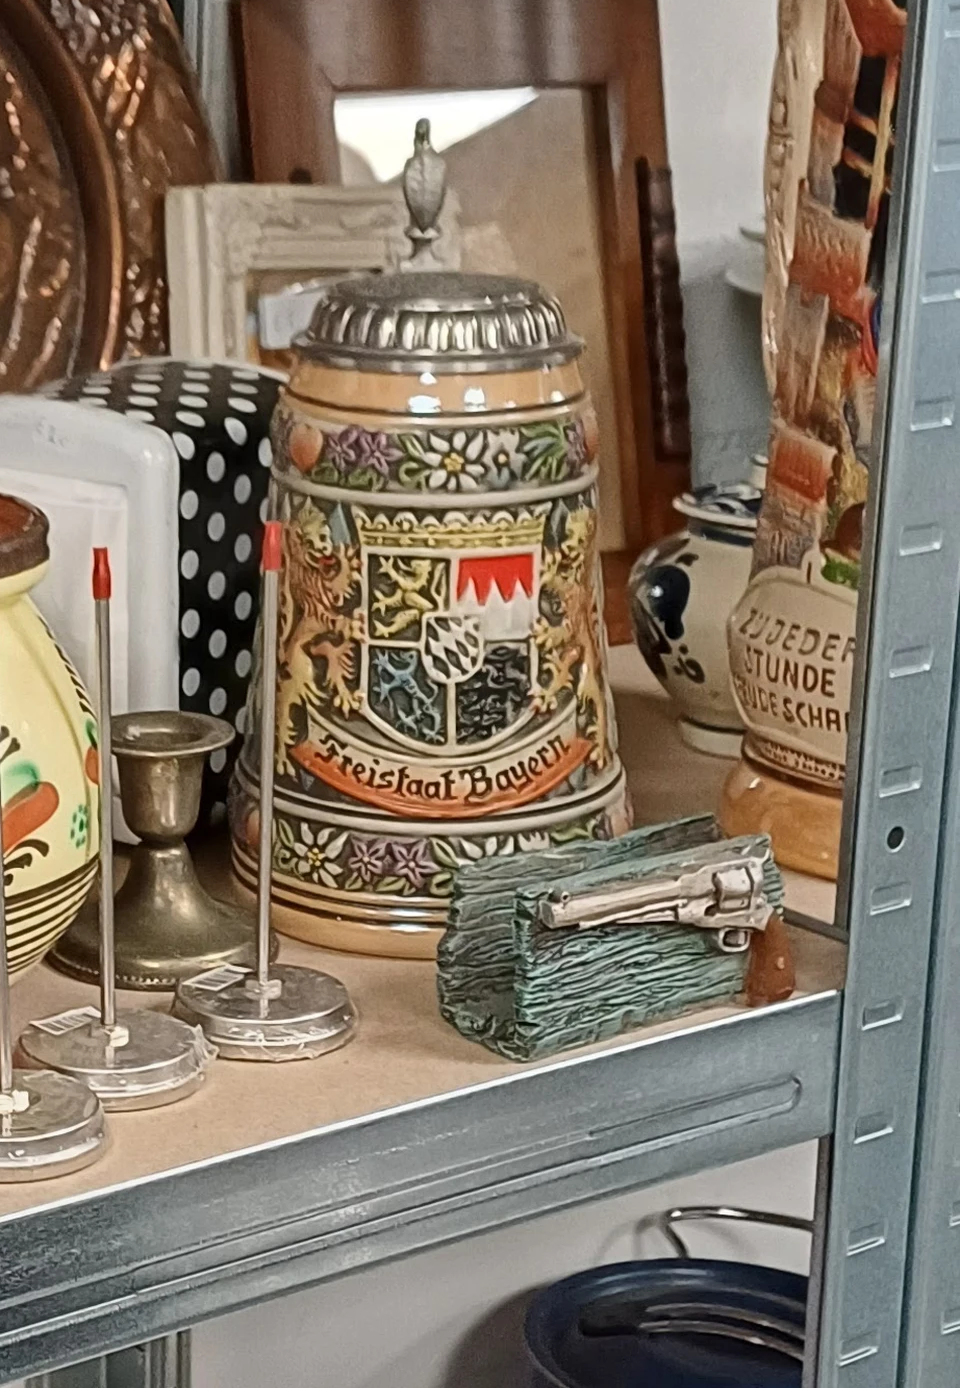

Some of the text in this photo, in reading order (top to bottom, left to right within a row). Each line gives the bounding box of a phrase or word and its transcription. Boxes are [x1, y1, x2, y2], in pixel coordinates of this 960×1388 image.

[744, 644, 837, 699] STUNDE
[782, 696, 850, 733] SCHA
[314, 734, 571, 805] Freistaat Bayern
